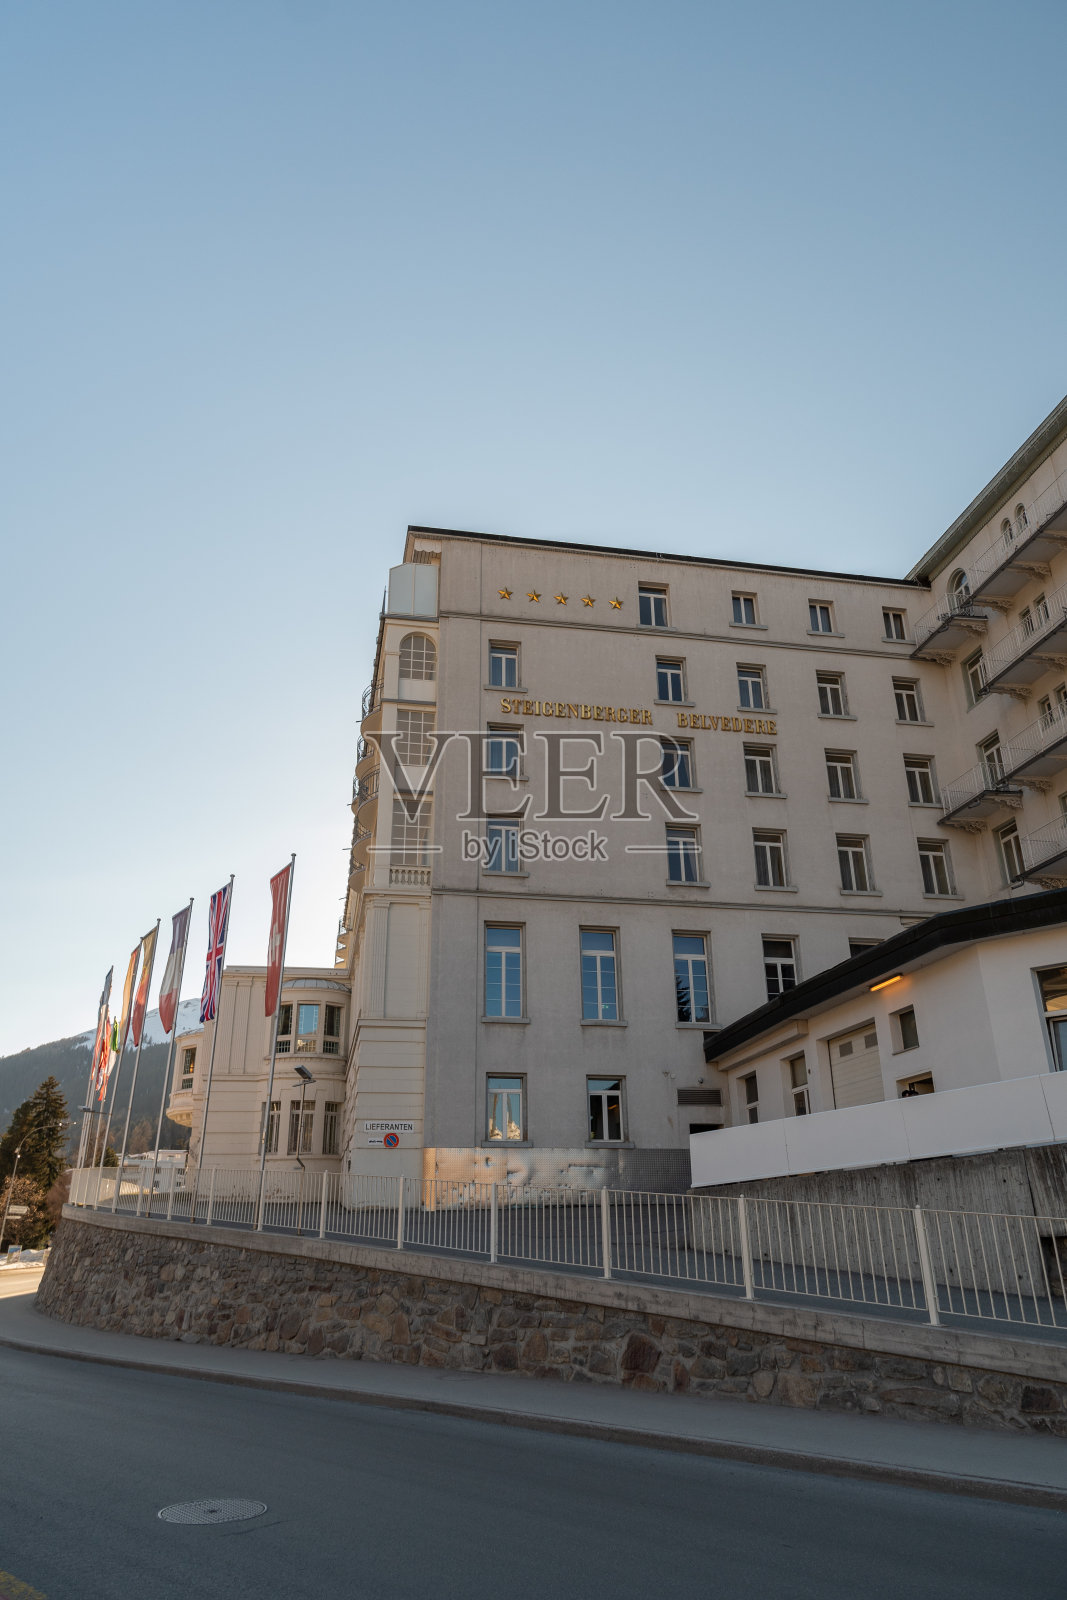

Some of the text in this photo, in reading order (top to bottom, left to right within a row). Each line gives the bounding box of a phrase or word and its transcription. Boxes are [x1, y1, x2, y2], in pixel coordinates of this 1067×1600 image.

[500, 698, 777, 735] STEIGENBERGER BELVEDERE
[365, 1123, 413, 1131] LIEFERANTEN
